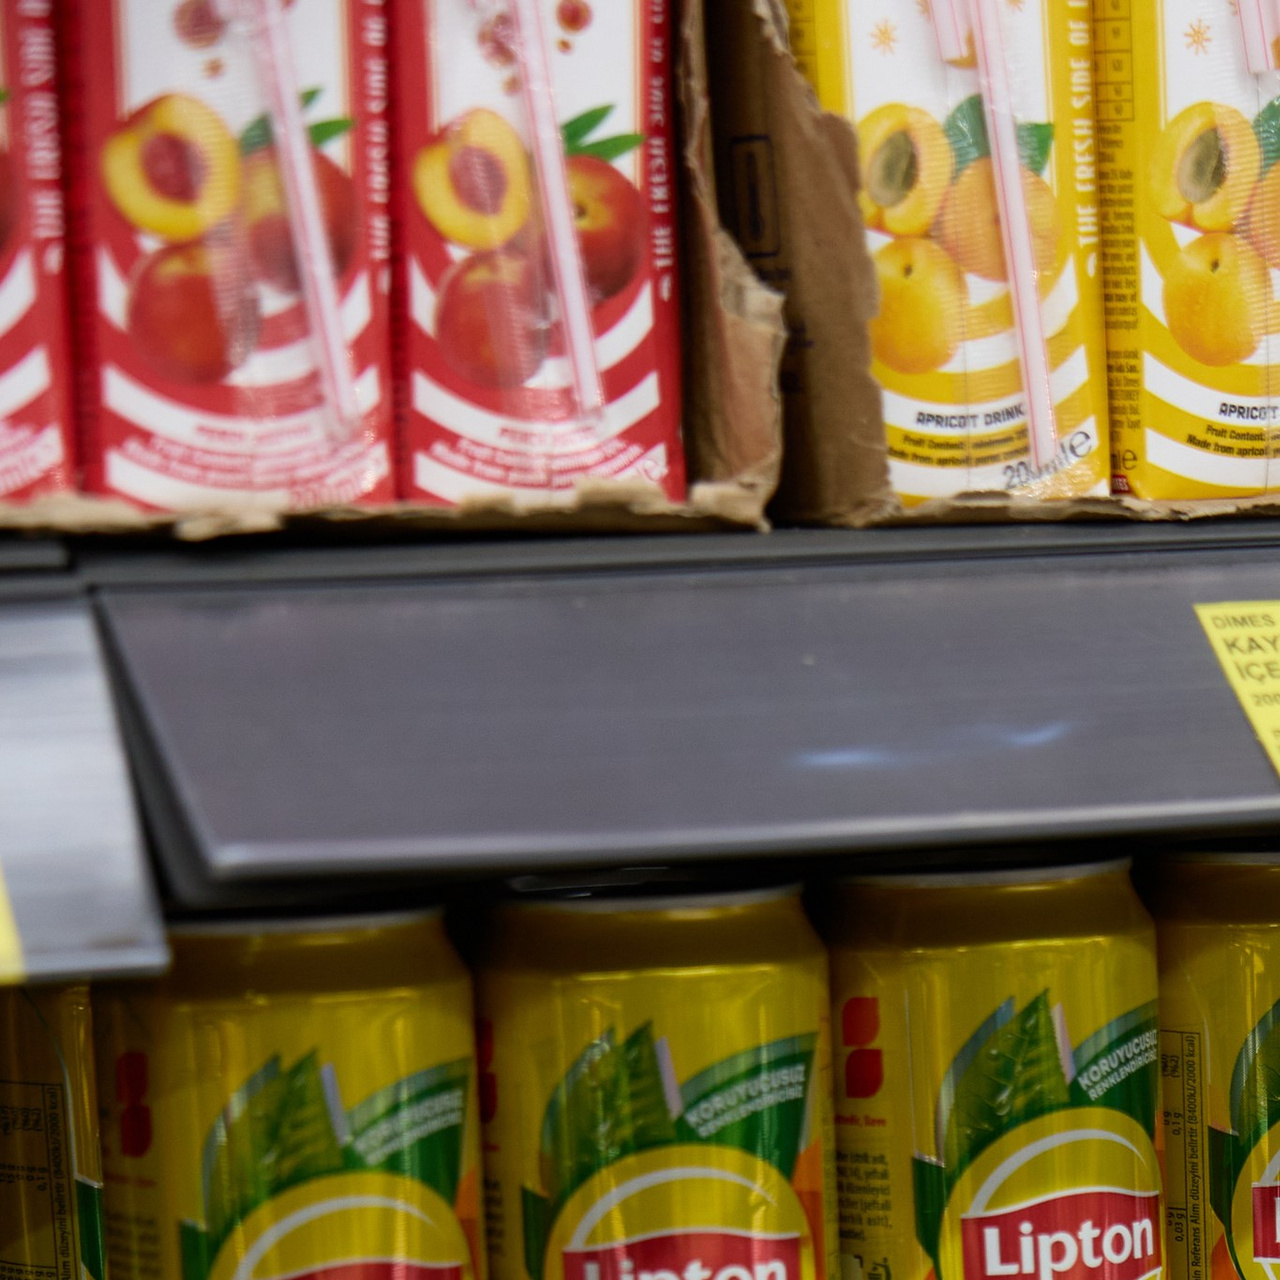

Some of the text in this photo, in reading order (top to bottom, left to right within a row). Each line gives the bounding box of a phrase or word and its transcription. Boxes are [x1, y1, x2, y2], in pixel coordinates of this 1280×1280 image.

[1068, 20, 1099, 248] THE FRESH SIDE OF
[916, 402, 1026, 429] APRICOT DRINK
[1218, 402, 1278, 421] APRICOT
[1077, 1028, 1159, 1092] KORUYUCUSUZ
